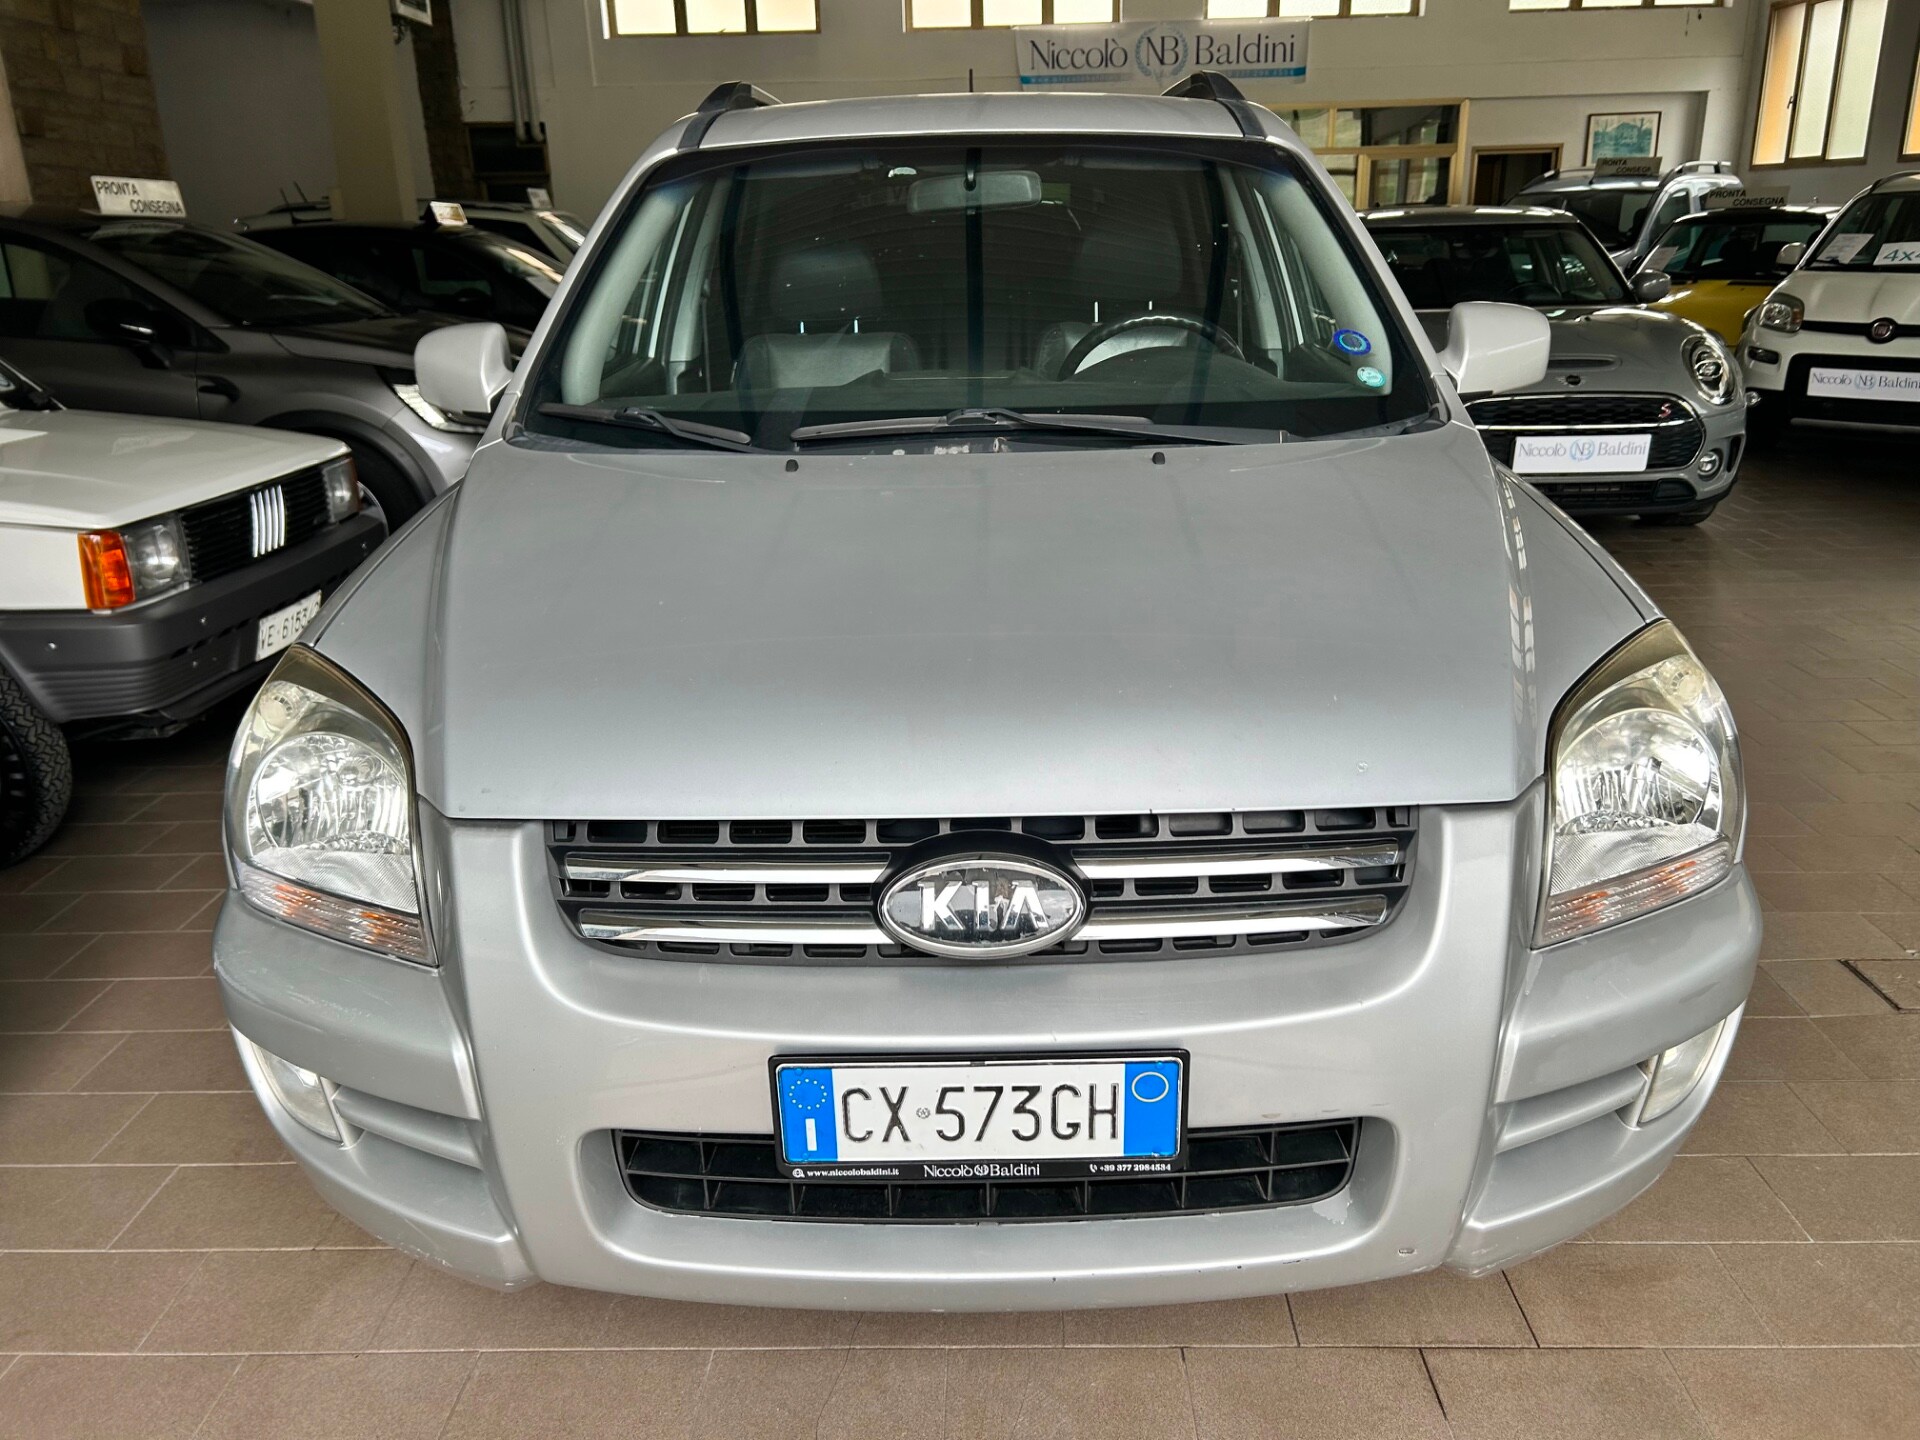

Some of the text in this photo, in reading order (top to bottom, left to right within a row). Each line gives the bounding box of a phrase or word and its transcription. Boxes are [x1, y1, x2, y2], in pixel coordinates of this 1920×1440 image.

[1030, 33, 1295, 70] Niccolò NB Baldini
[96, 181, 139, 196] PRONTA
[1709, 188, 1747, 199] PRONTA
[130, 199, 183, 214] CONSEGNA
[1732, 196, 1786, 207] CONSEGNA
[1658, 403, 1672, 418] S
[1518, 443, 1567, 458] Niccolò
[1597, 441, 1647, 456] Baldini
[917, 880, 1049, 932] KIA
[841, 1086, 911, 1142] CX
[935, 1083, 1119, 1142] 573GH
[807, 1167, 900, 1177] www.niccolobaldini.it
[923, 1164, 974, 1178] Niccolò
[989, 1163, 1040, 1177] Baldini
[1117, 1163, 1132, 1172] 377
